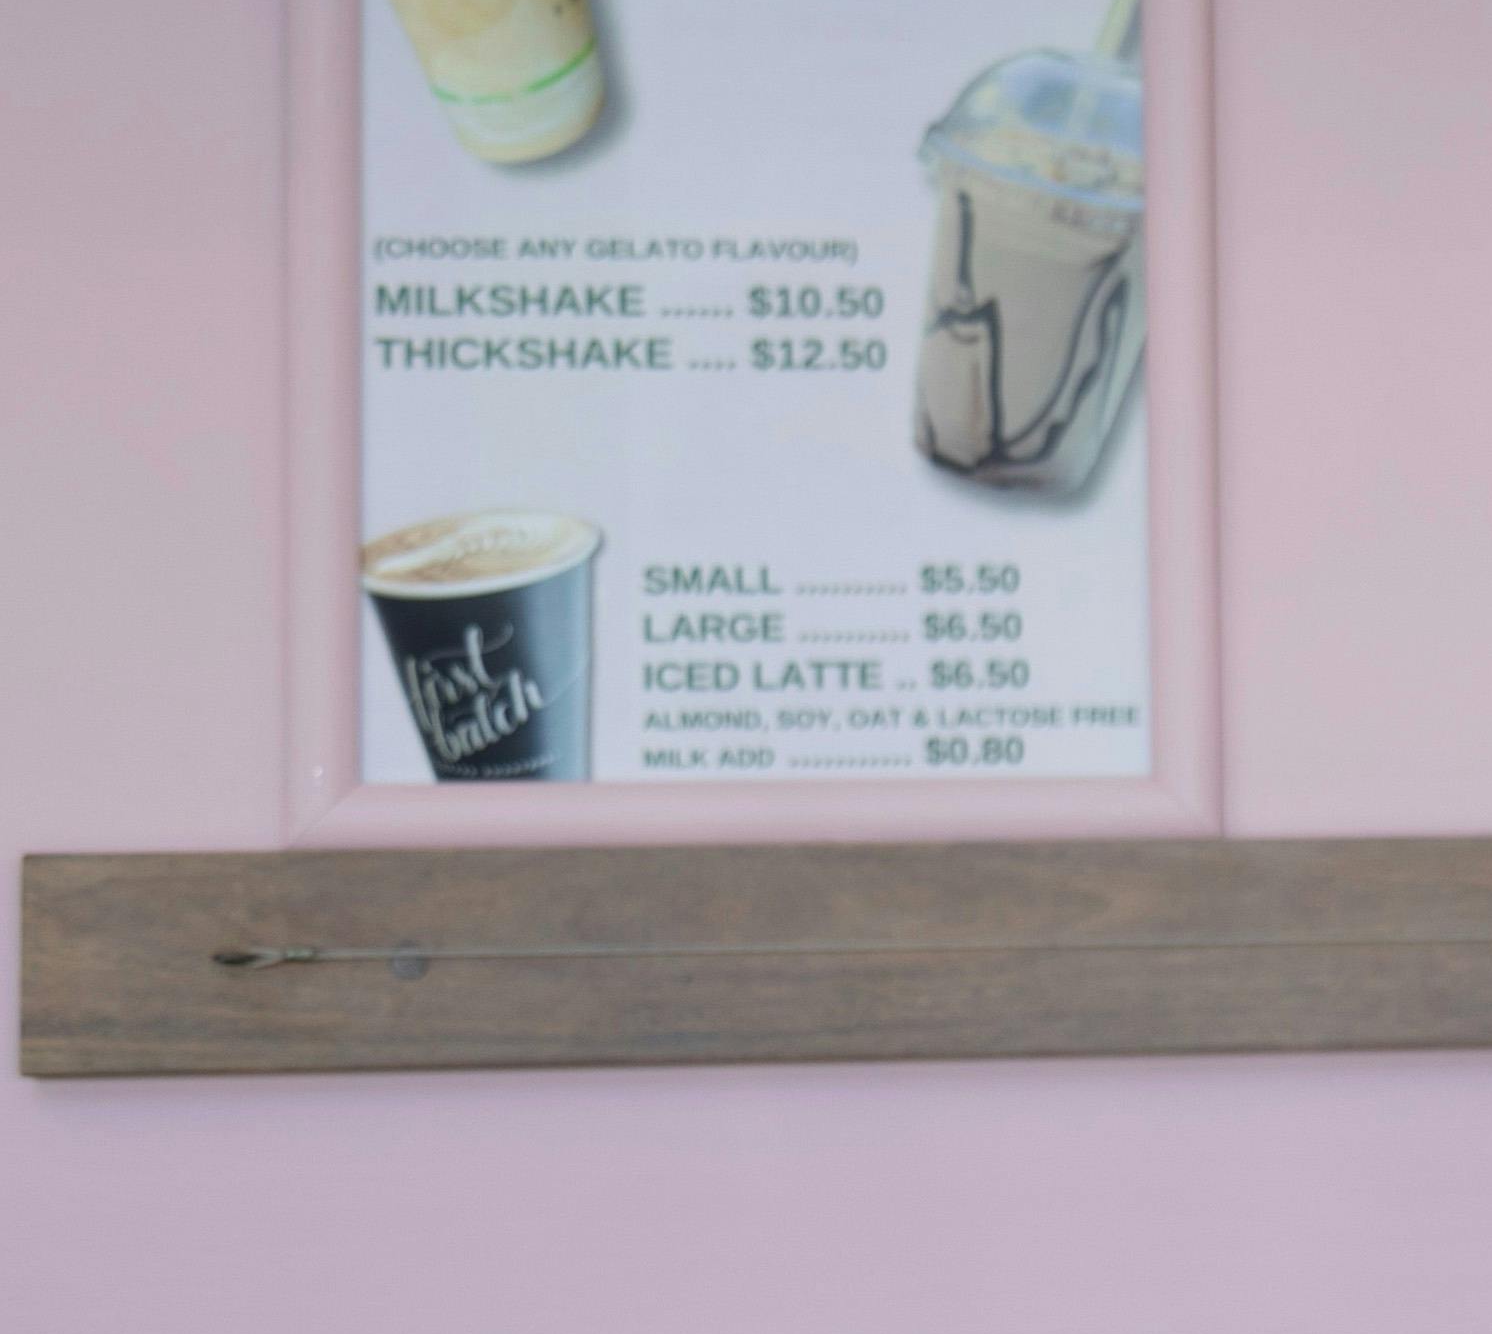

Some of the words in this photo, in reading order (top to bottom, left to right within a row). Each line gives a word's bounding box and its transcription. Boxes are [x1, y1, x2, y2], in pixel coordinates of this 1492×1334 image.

[372, 237, 506, 262] (CHOOSE
[517, 237, 575, 262] ANY
[583, 237, 704, 261] GELATO
[710, 238, 859, 265] FLAVOUR)
[374, 284, 641, 318] MILKSHAKE
[747, 284, 885, 320] $10.50
[375, 337, 670, 371] THICKSHAKE
[749, 337, 888, 372] $12.50
[643, 565, 780, 596] SMALL
[919, 563, 1021, 595] $5.50
[642, 612, 782, 644] LARGE
[922, 611, 1023, 642] $6.50
[643, 661, 741, 693] ICED
[752, 659, 880, 692] LATTE
[929, 658, 1030, 691] $6.50
[642, 707, 769, 735] ALMOND,
[846, 707, 902, 729] OAT
[912, 708, 929, 729] &
[937, 705, 1062, 729] LACTOSE
[1071, 705, 1138, 726] FREE
[642, 746, 708, 770] MILK
[717, 747, 775, 769] ADD
[924, 735, 1025, 766] $0.80
